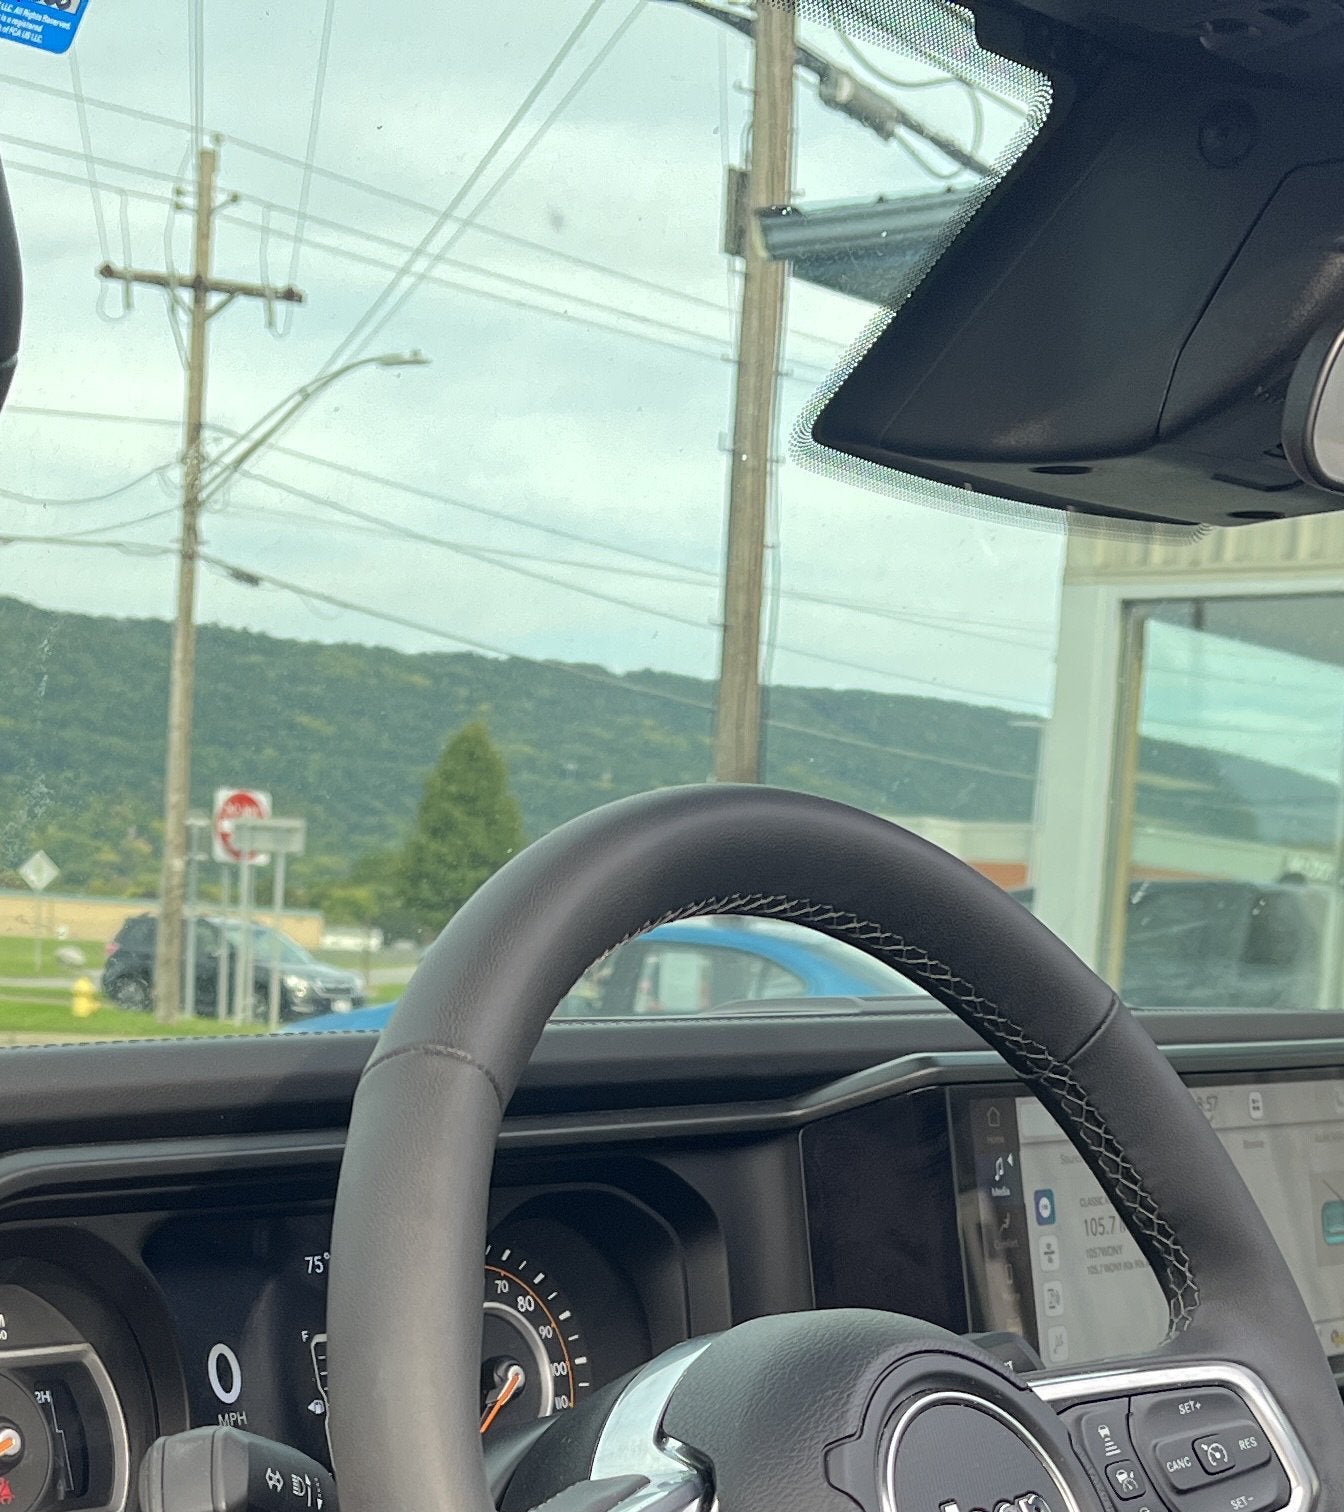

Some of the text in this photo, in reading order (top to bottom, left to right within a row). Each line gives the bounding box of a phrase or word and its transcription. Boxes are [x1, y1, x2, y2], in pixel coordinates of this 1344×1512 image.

[1084, 1215, 1116, 1237] 105.7
[495, 1280, 509, 1294] 70
[517, 1295, 535, 1312] 80
[301, 1331, 309, 1342] F
[539, 1325, 553, 1339] 90
[208, 1343, 242, 1404] 0
[550, 1362, 568, 1377] 100
[218, 1411, 248, 1428] MPH
[1238, 1436, 1258, 1451] RES
[1166, 1456, 1192, 1473] CANC
